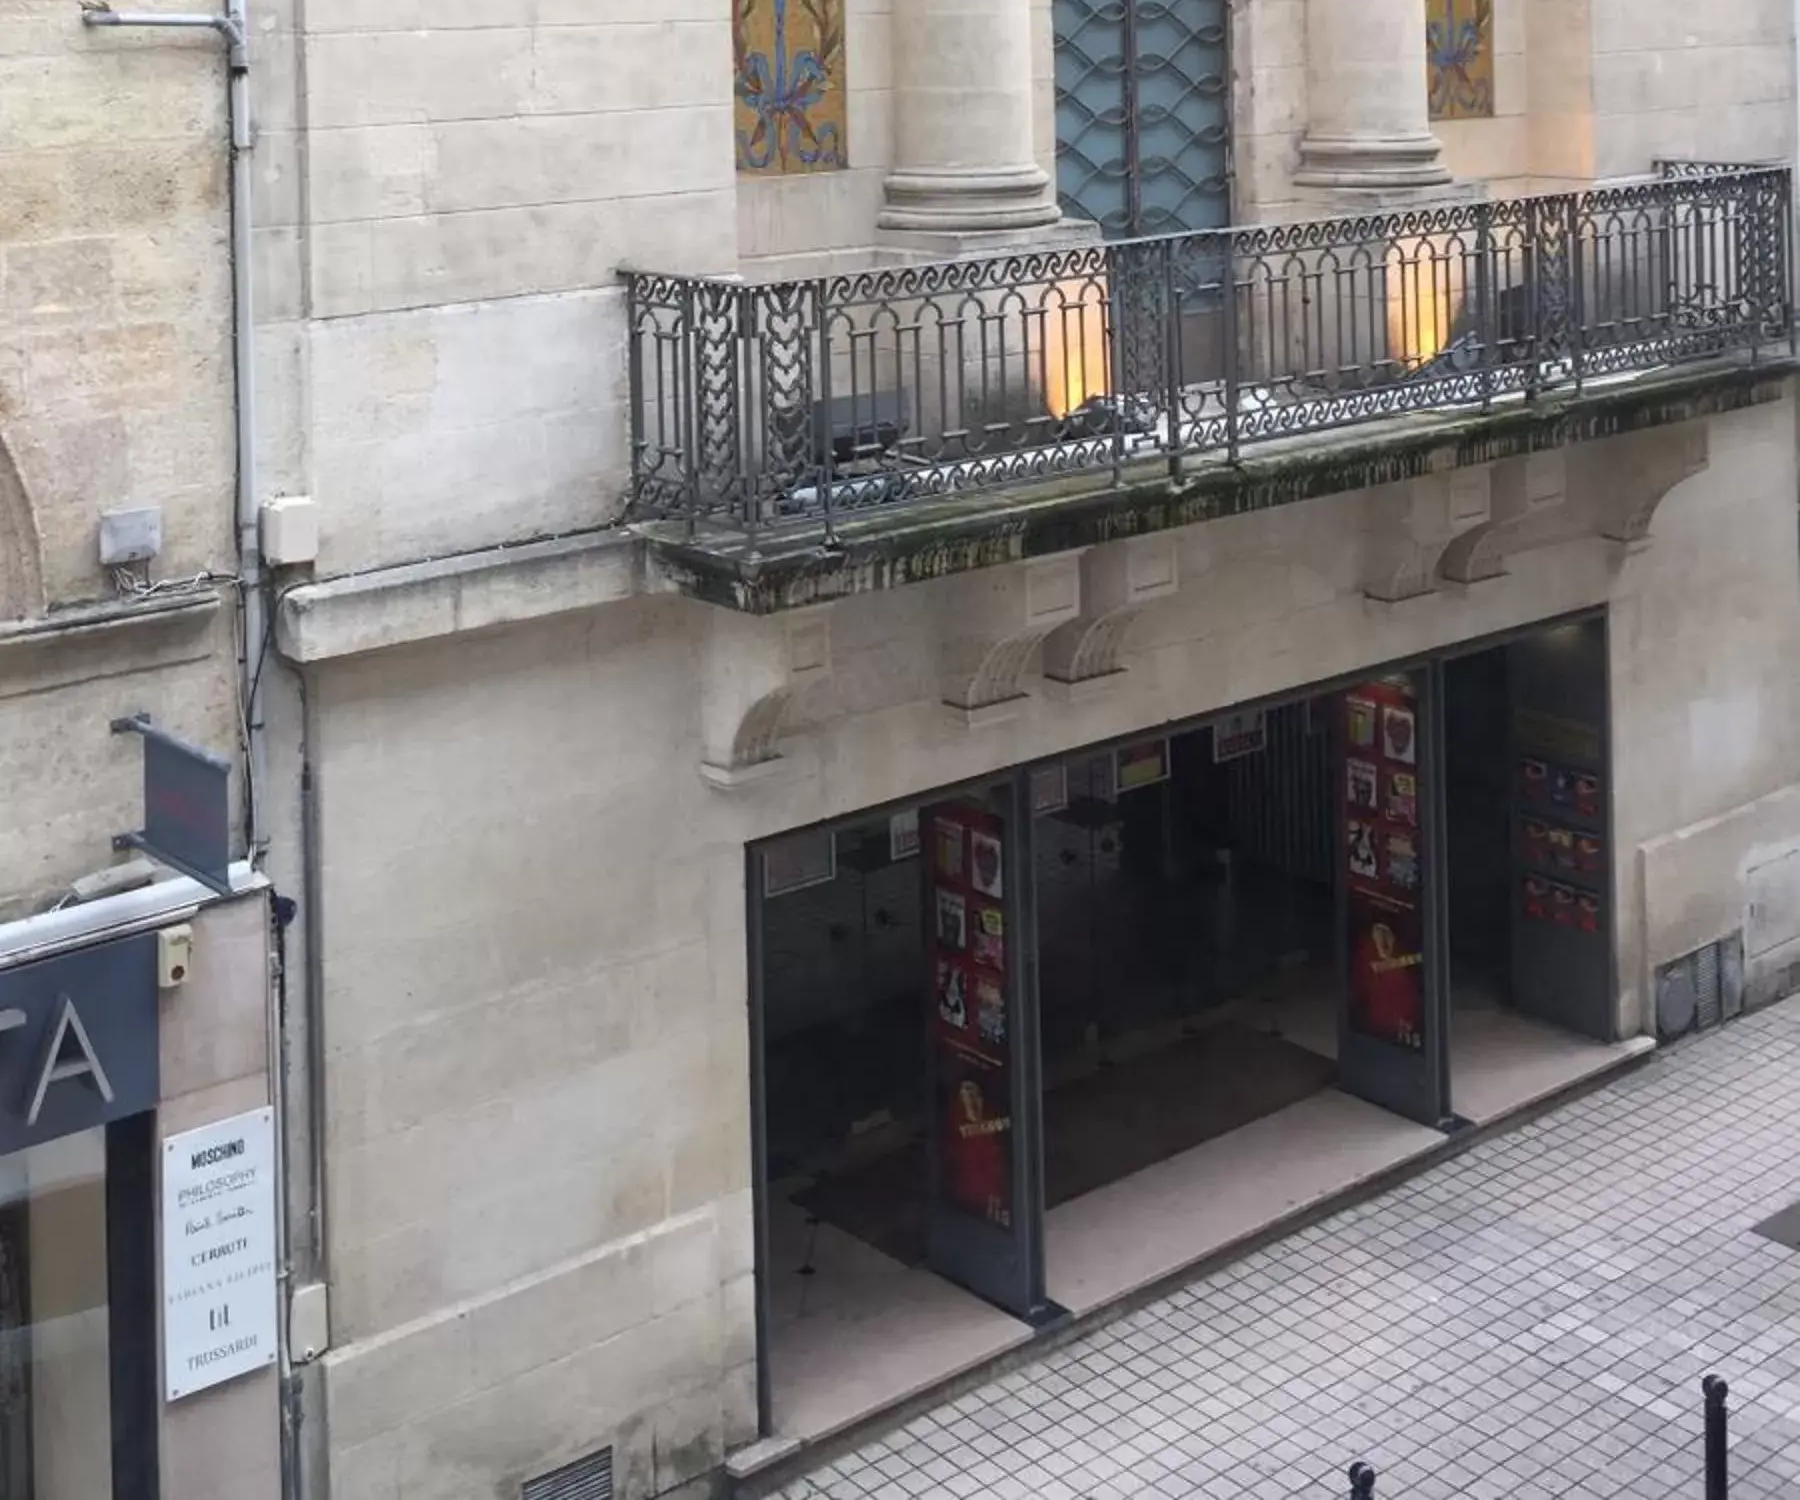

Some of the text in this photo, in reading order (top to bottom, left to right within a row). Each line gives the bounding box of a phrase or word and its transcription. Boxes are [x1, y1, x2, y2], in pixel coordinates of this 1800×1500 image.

[191, 1139, 245, 1170] MOSCHINO
[178, 1166, 257, 1202] PHILOSOPHY
[191, 1236, 247, 1267] CERRUTI
[187, 1333, 258, 1372] TRUSSARDI
